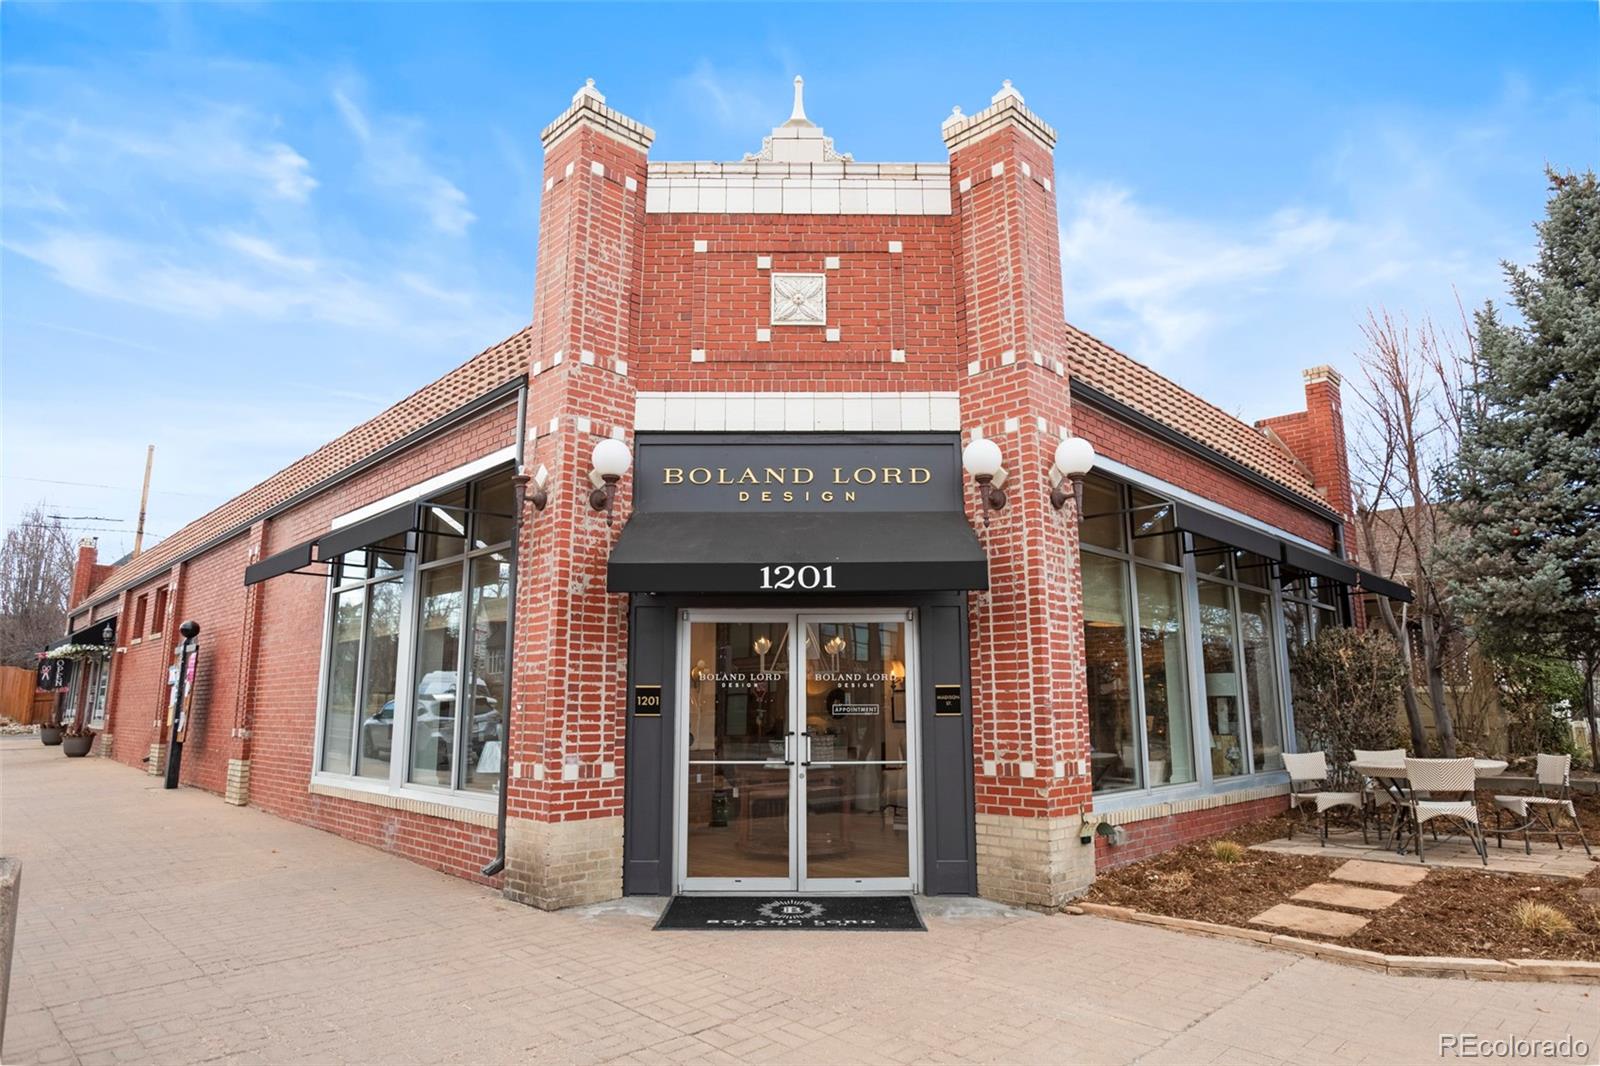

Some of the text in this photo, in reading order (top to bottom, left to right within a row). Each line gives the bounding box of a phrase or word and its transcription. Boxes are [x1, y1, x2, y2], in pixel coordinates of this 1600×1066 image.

[663, 467, 932, 485] BOLAND LORD
[739, 491, 856, 502] DESIGN
[759, 565, 836, 589] 1201
[55, 659, 65, 687] OPEN
[699, 673, 781, 681] BOLAND LORD
[815, 673, 897, 681] BOLAND LORD
[637, 695, 660, 706] 1201
